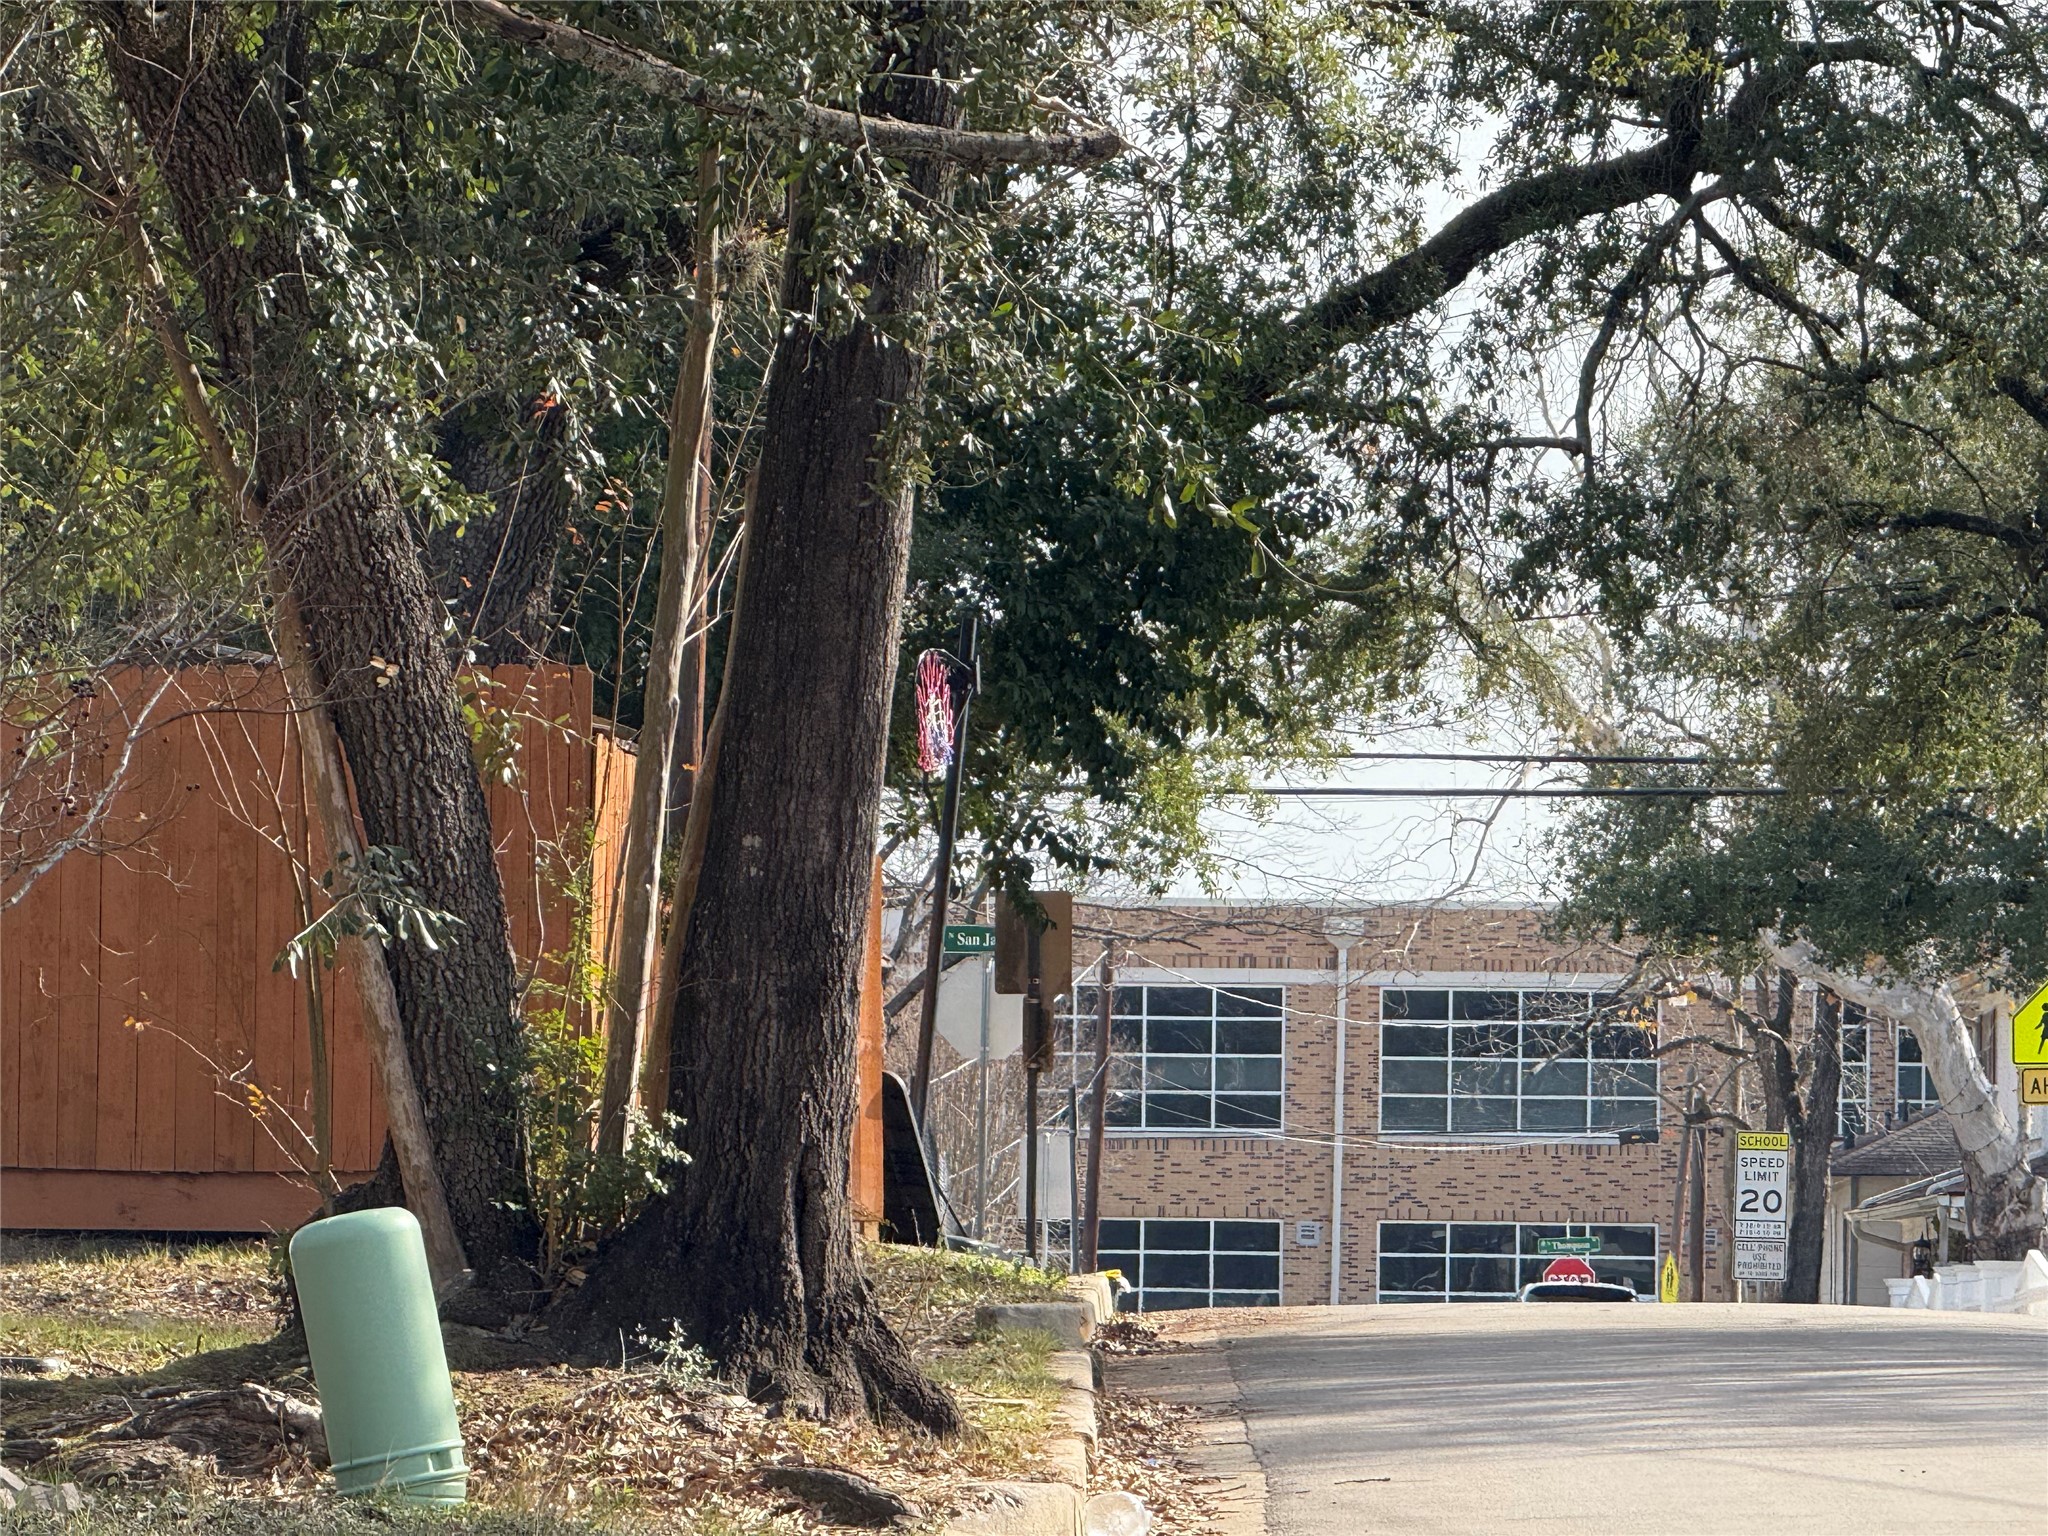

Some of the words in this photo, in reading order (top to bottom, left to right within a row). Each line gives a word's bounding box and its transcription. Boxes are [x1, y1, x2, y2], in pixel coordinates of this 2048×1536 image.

[956, 932, 980, 946] San
[1739, 1136, 1787, 1147] SCHOOL
[1740, 1157, 1785, 1168] SPEED
[1744, 1171, 1779, 1182] LIMIT
[1739, 1188, 1783, 1214] 20
[1736, 1243, 1756, 1252] CELL
[1757, 1243, 1784, 1253] PHONE
[1752, 1253, 1767, 1262] USE
[1737, 1261, 1782, 1271] PROHIBITED
